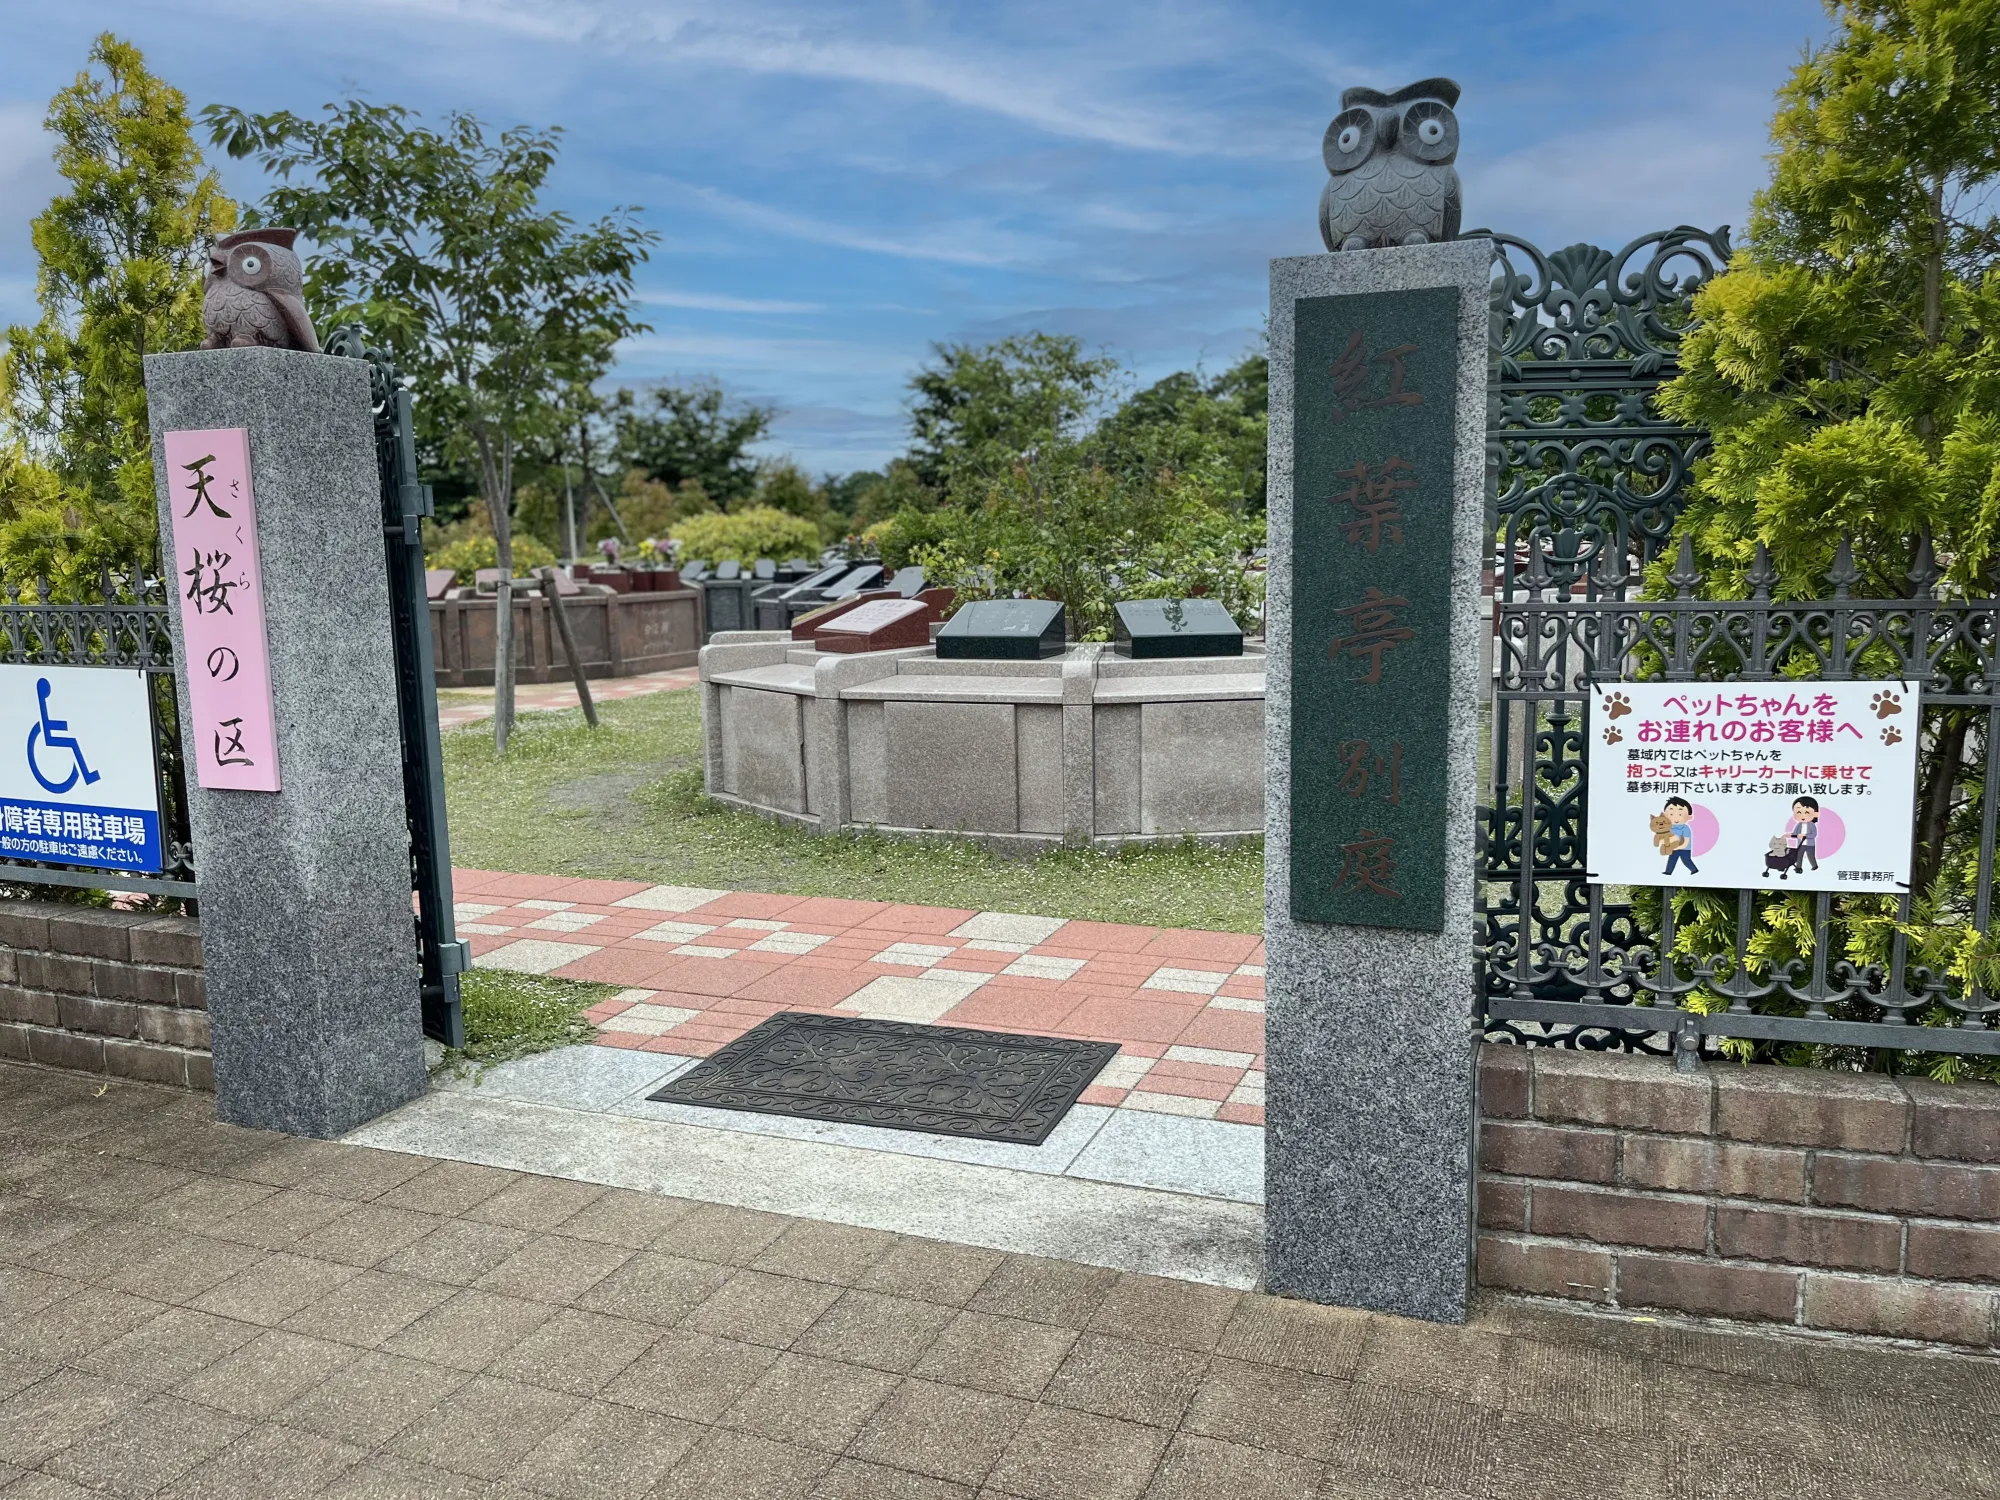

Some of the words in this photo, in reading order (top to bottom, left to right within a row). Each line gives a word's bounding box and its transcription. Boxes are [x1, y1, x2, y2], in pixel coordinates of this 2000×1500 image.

[229, 479, 251, 590] さくら
[181, 454, 254, 767] 天桜の区
[1328, 327, 1425, 898] 紅葉亭別庭
[1663, 693, 1838, 717] ペットちゃんを
[1637, 719, 1863, 743] お連れのお客様へ
[1627, 749, 1782, 762] 墓域内ではペットちゃんを
[1626, 764, 1873, 780] 抱っこ又はキャリーカートに乗せて
[1626, 781, 1872, 796] 墓参利用下さいますようお願い致します。
[0, 805, 146, 846] 障者専用駐車場
[0, 835, 144, 864] 般の方の駐車はご遠慮ください。
[1837, 870, 1895, 882] 管理事務所
[837, 1058, 953, 1077] WELCOME
